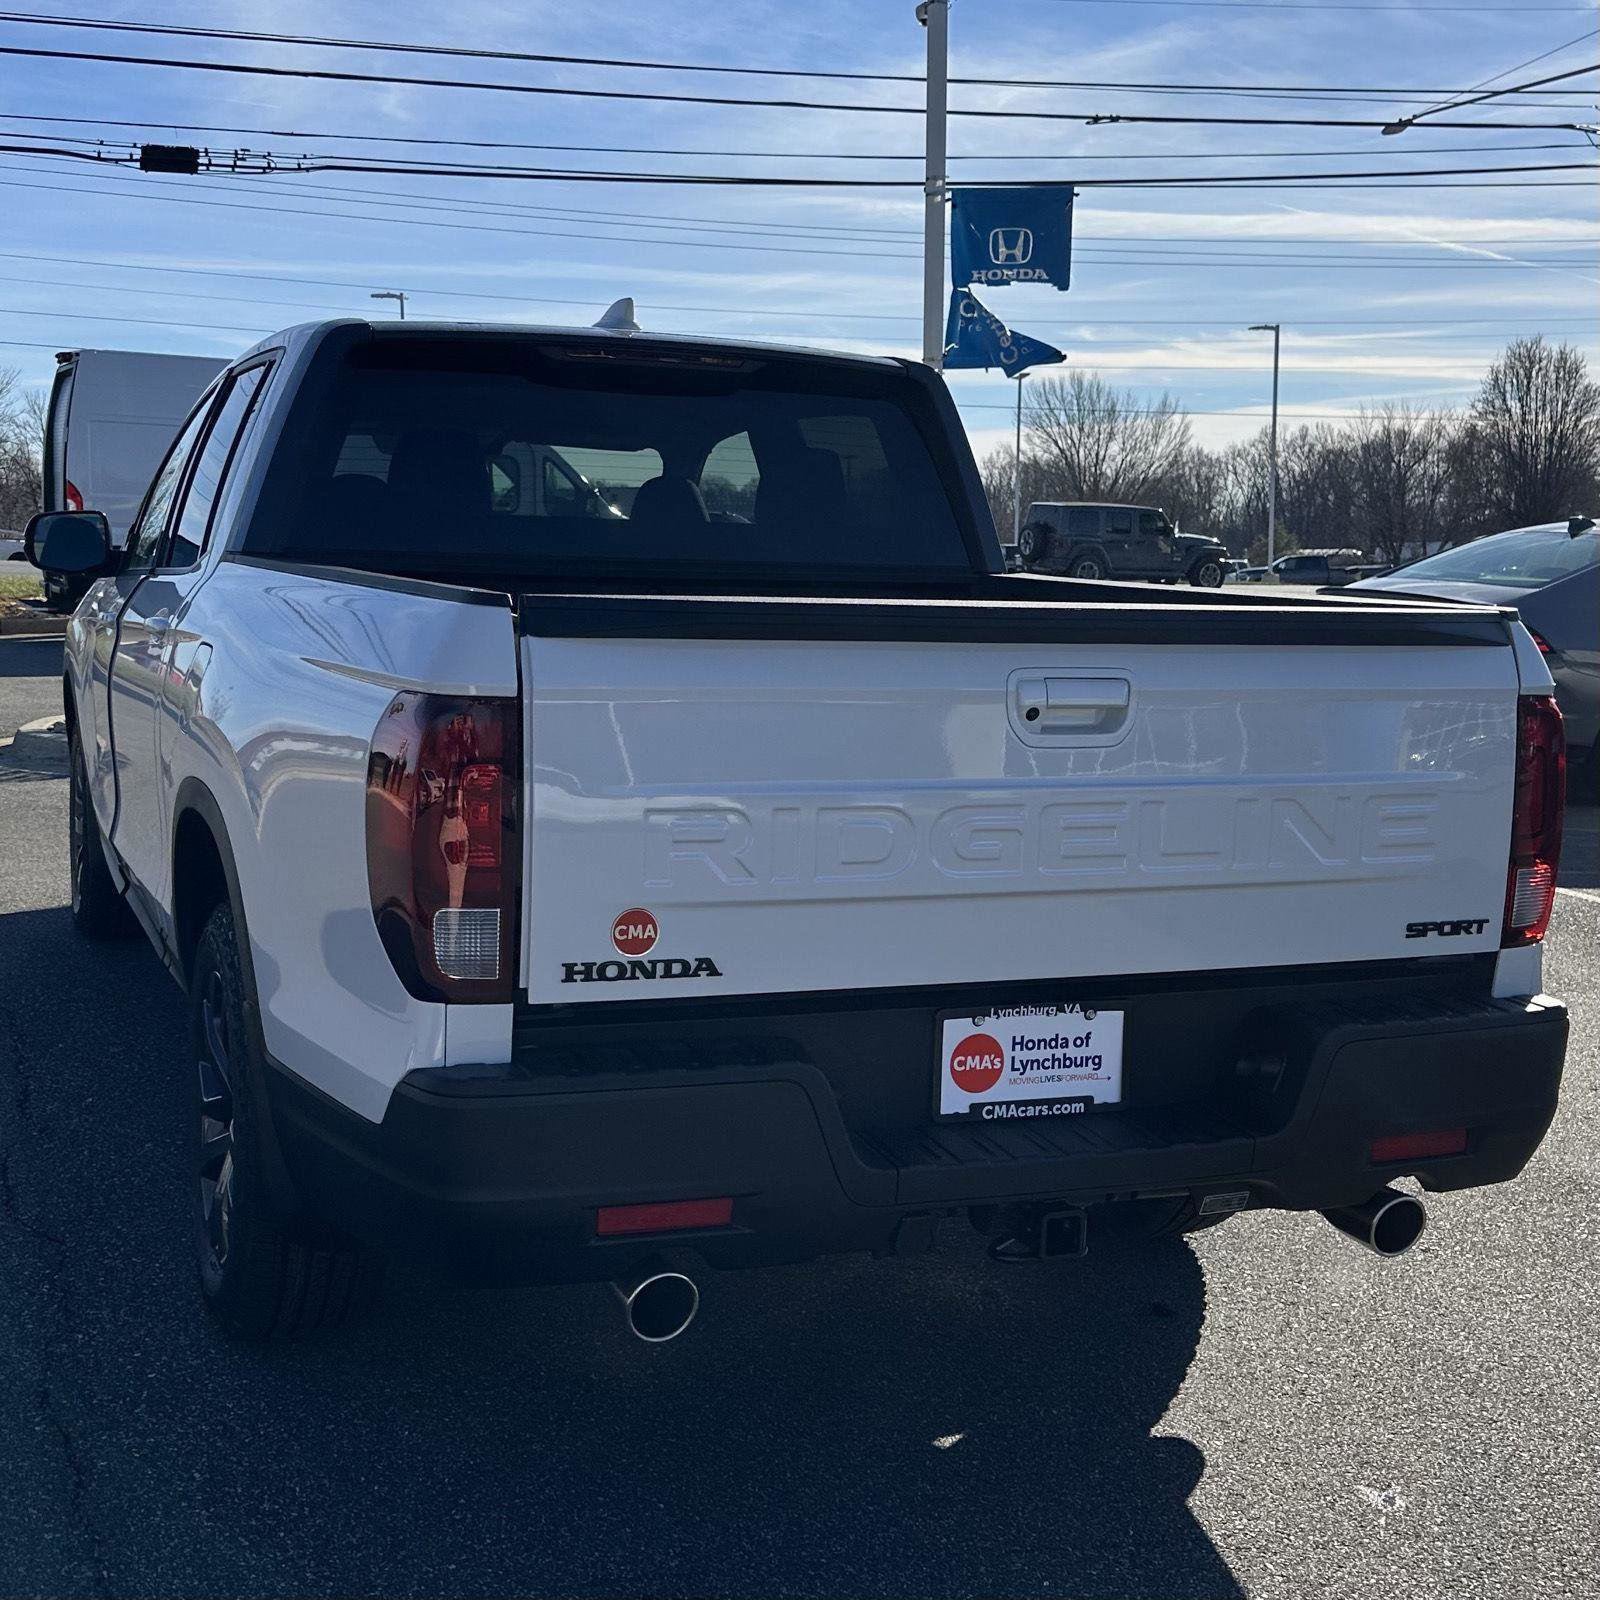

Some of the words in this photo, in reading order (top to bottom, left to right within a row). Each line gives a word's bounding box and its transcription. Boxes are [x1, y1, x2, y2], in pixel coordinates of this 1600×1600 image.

[971, 269, 1049, 281] HONDA
[643, 794, 1439, 888] RIDGELINE
[614, 924, 656, 940] CMA
[1405, 919, 1490, 938] SPORT
[561, 957, 723, 983] HONDA
[1064, 1003, 1081, 1014] VA
[1011, 1033, 1069, 1052] Honda
[1072, 1031, 1092, 1048] of
[953, 1055, 1002, 1072] CMA's
[1010, 1054, 1102, 1075] Lynchburg
[981, 1102, 1085, 1120] CMAcars.com
